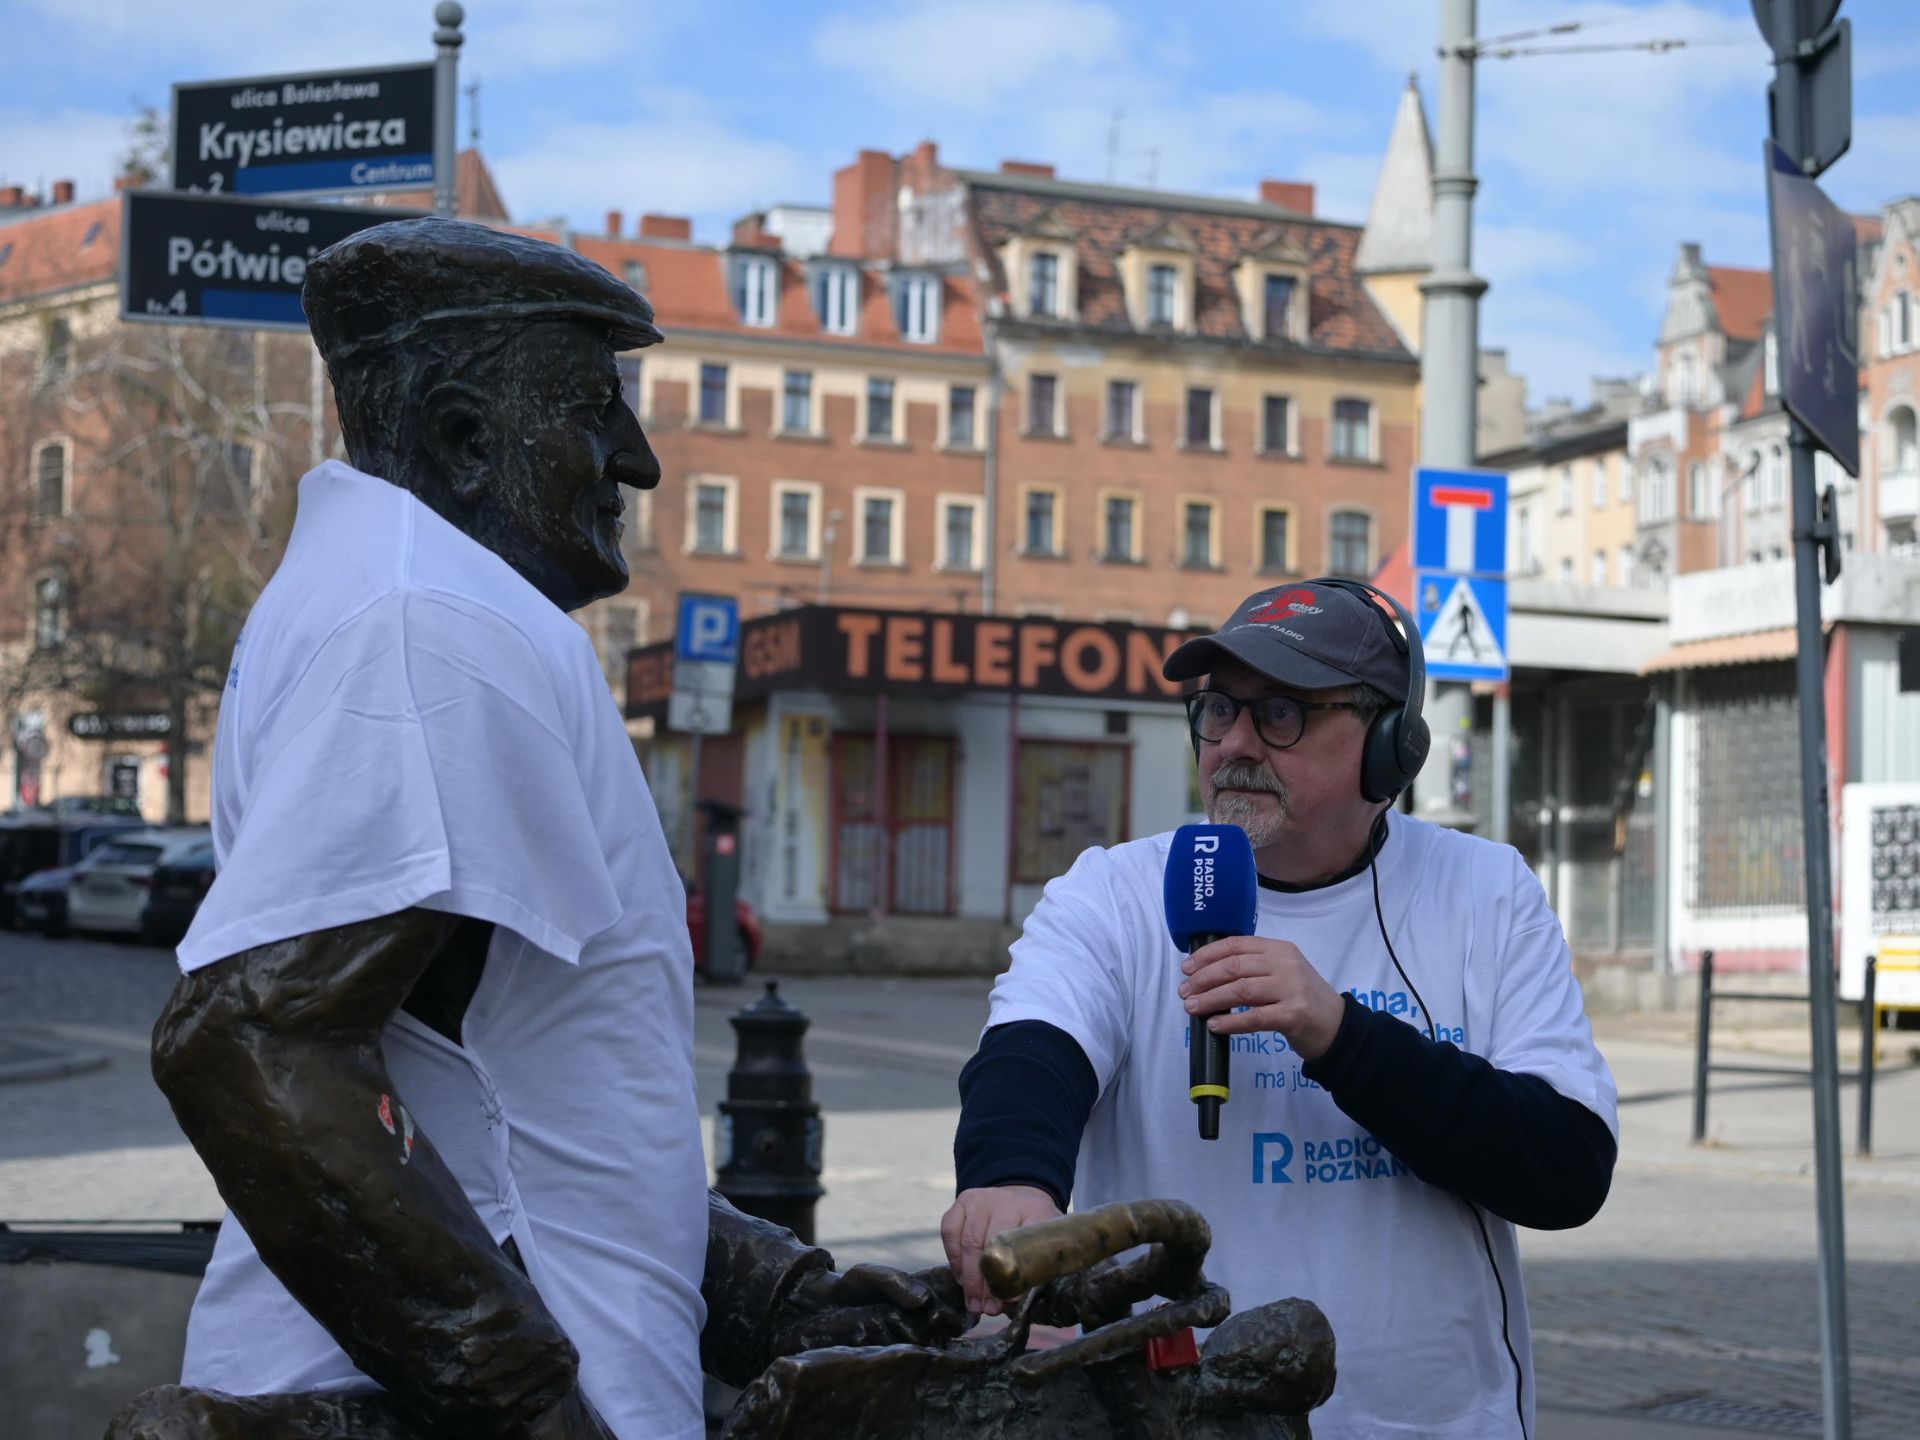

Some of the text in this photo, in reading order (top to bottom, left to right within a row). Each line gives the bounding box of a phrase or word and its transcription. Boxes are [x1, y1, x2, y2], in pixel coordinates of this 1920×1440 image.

[231, 80, 379, 109] ulica Bolesława
[200, 112, 405, 169] Krysiewicza
[209, 172, 225, 195] 2
[351, 162, 431, 185] Centrum
[256, 210, 309, 233] ulica
[168, 236, 317, 285] Półwie
[169, 289, 187, 315] 4
[690, 607, 729, 653] P
[1269, 625, 1305, 641] RADIO
[837, 613, 1197, 695] TELEFON
[1193, 858, 1206, 911] POZNAŃ
[1204, 858, 1215, 897] RADIO
[1255, 1071, 1285, 1089] ma
[1304, 1137, 1381, 1162] RADIO
